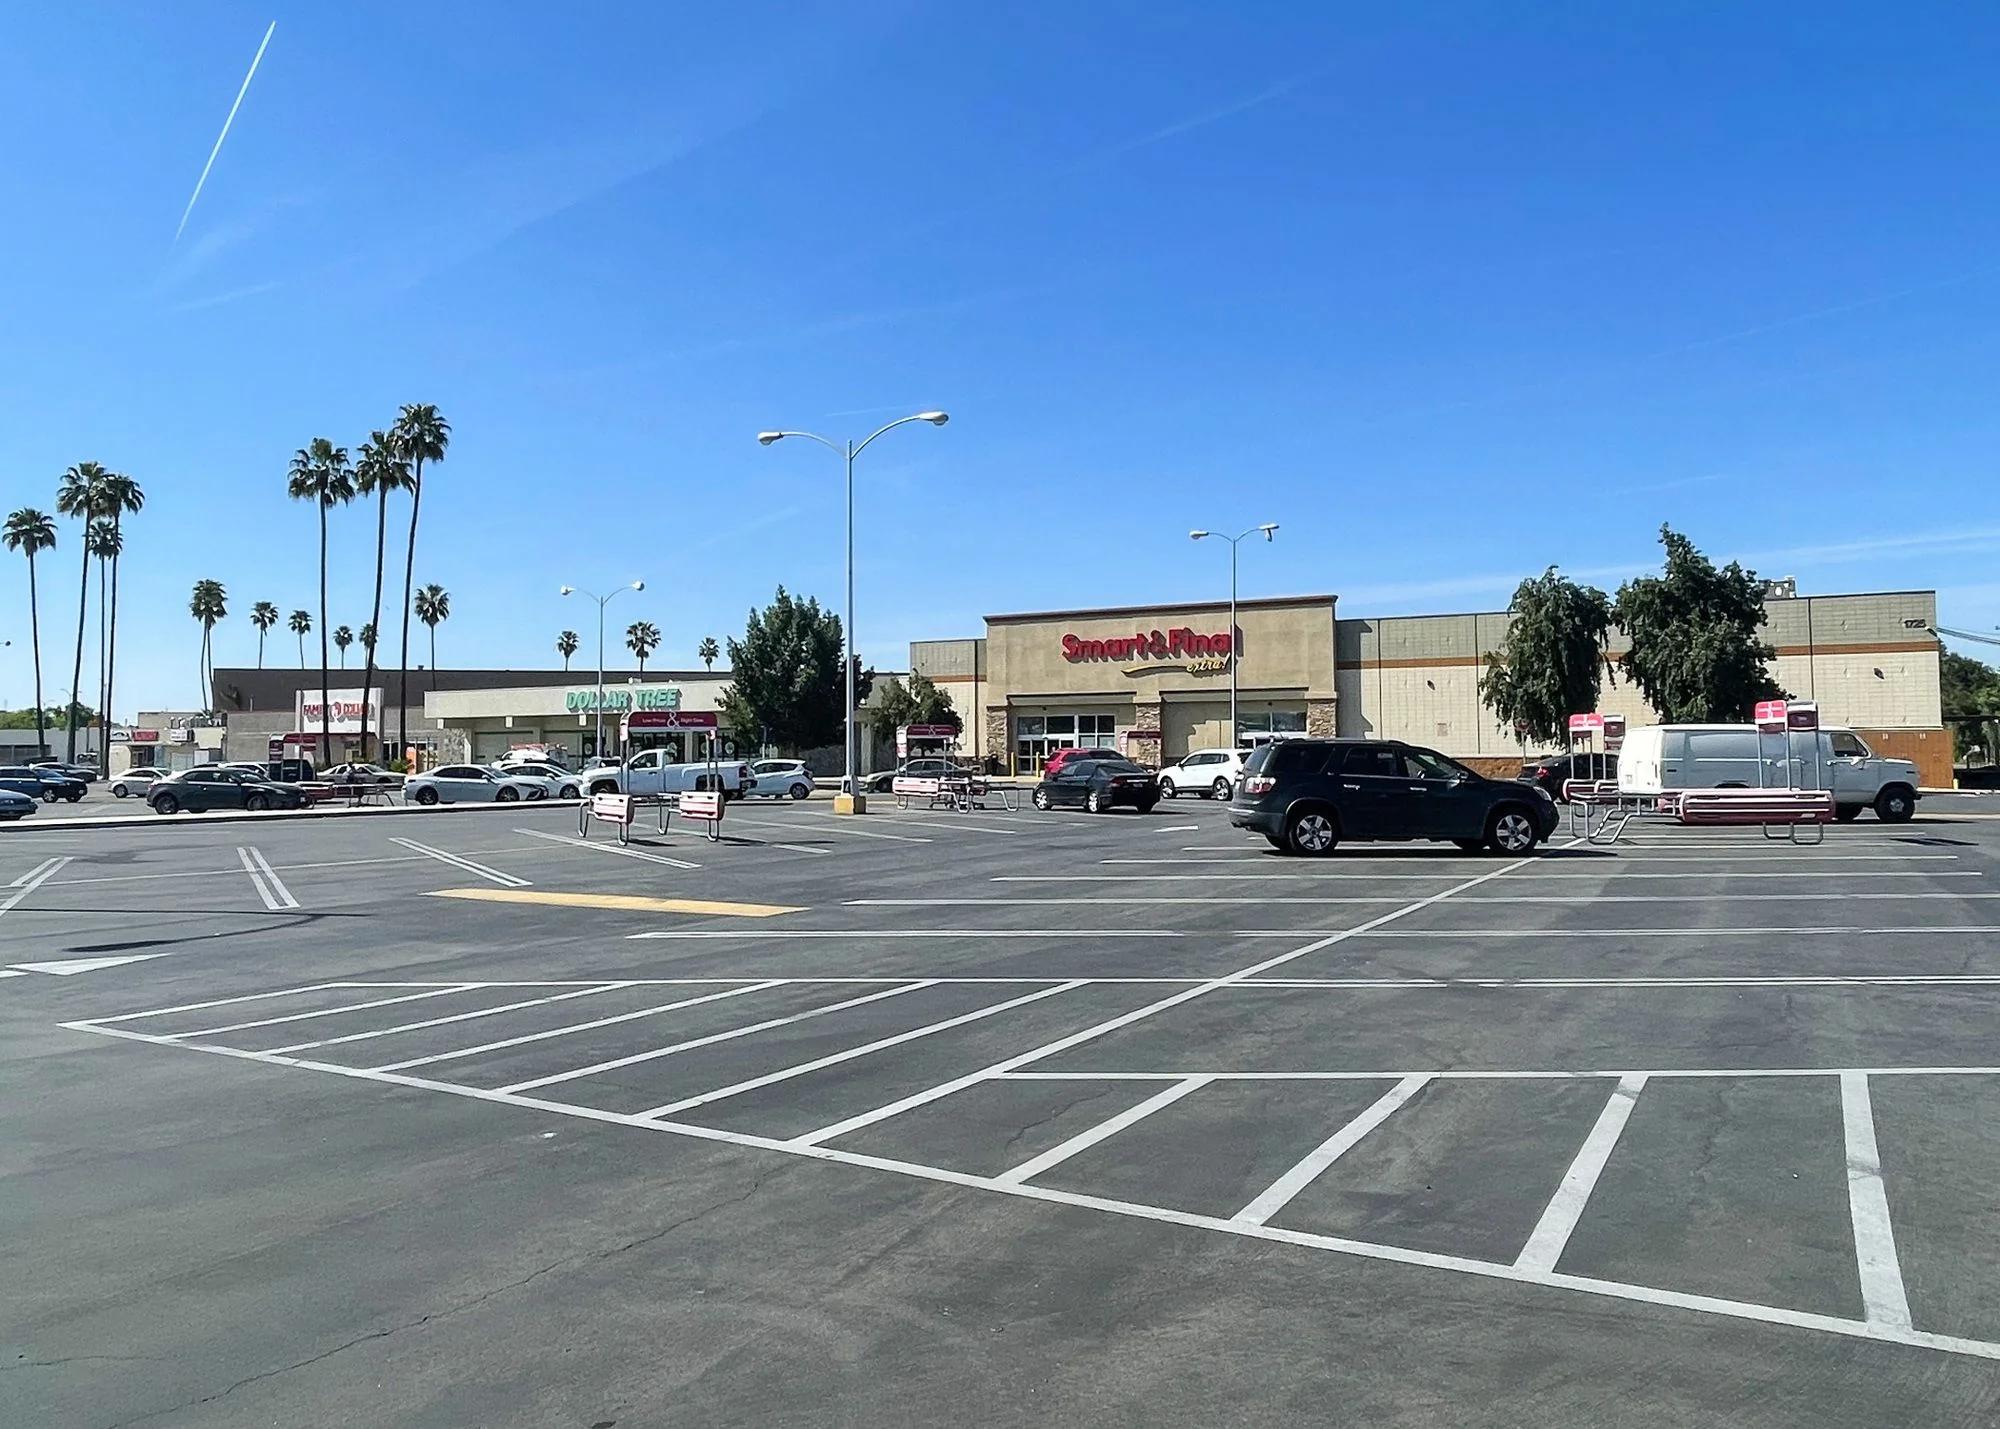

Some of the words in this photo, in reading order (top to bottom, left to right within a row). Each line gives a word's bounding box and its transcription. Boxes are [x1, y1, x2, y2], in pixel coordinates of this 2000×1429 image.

[1062, 633, 1145, 658] Smart
[1169, 626, 1236, 654] Fina
[636, 689, 678, 706] TREE
[303, 704, 328, 716] FAMI
